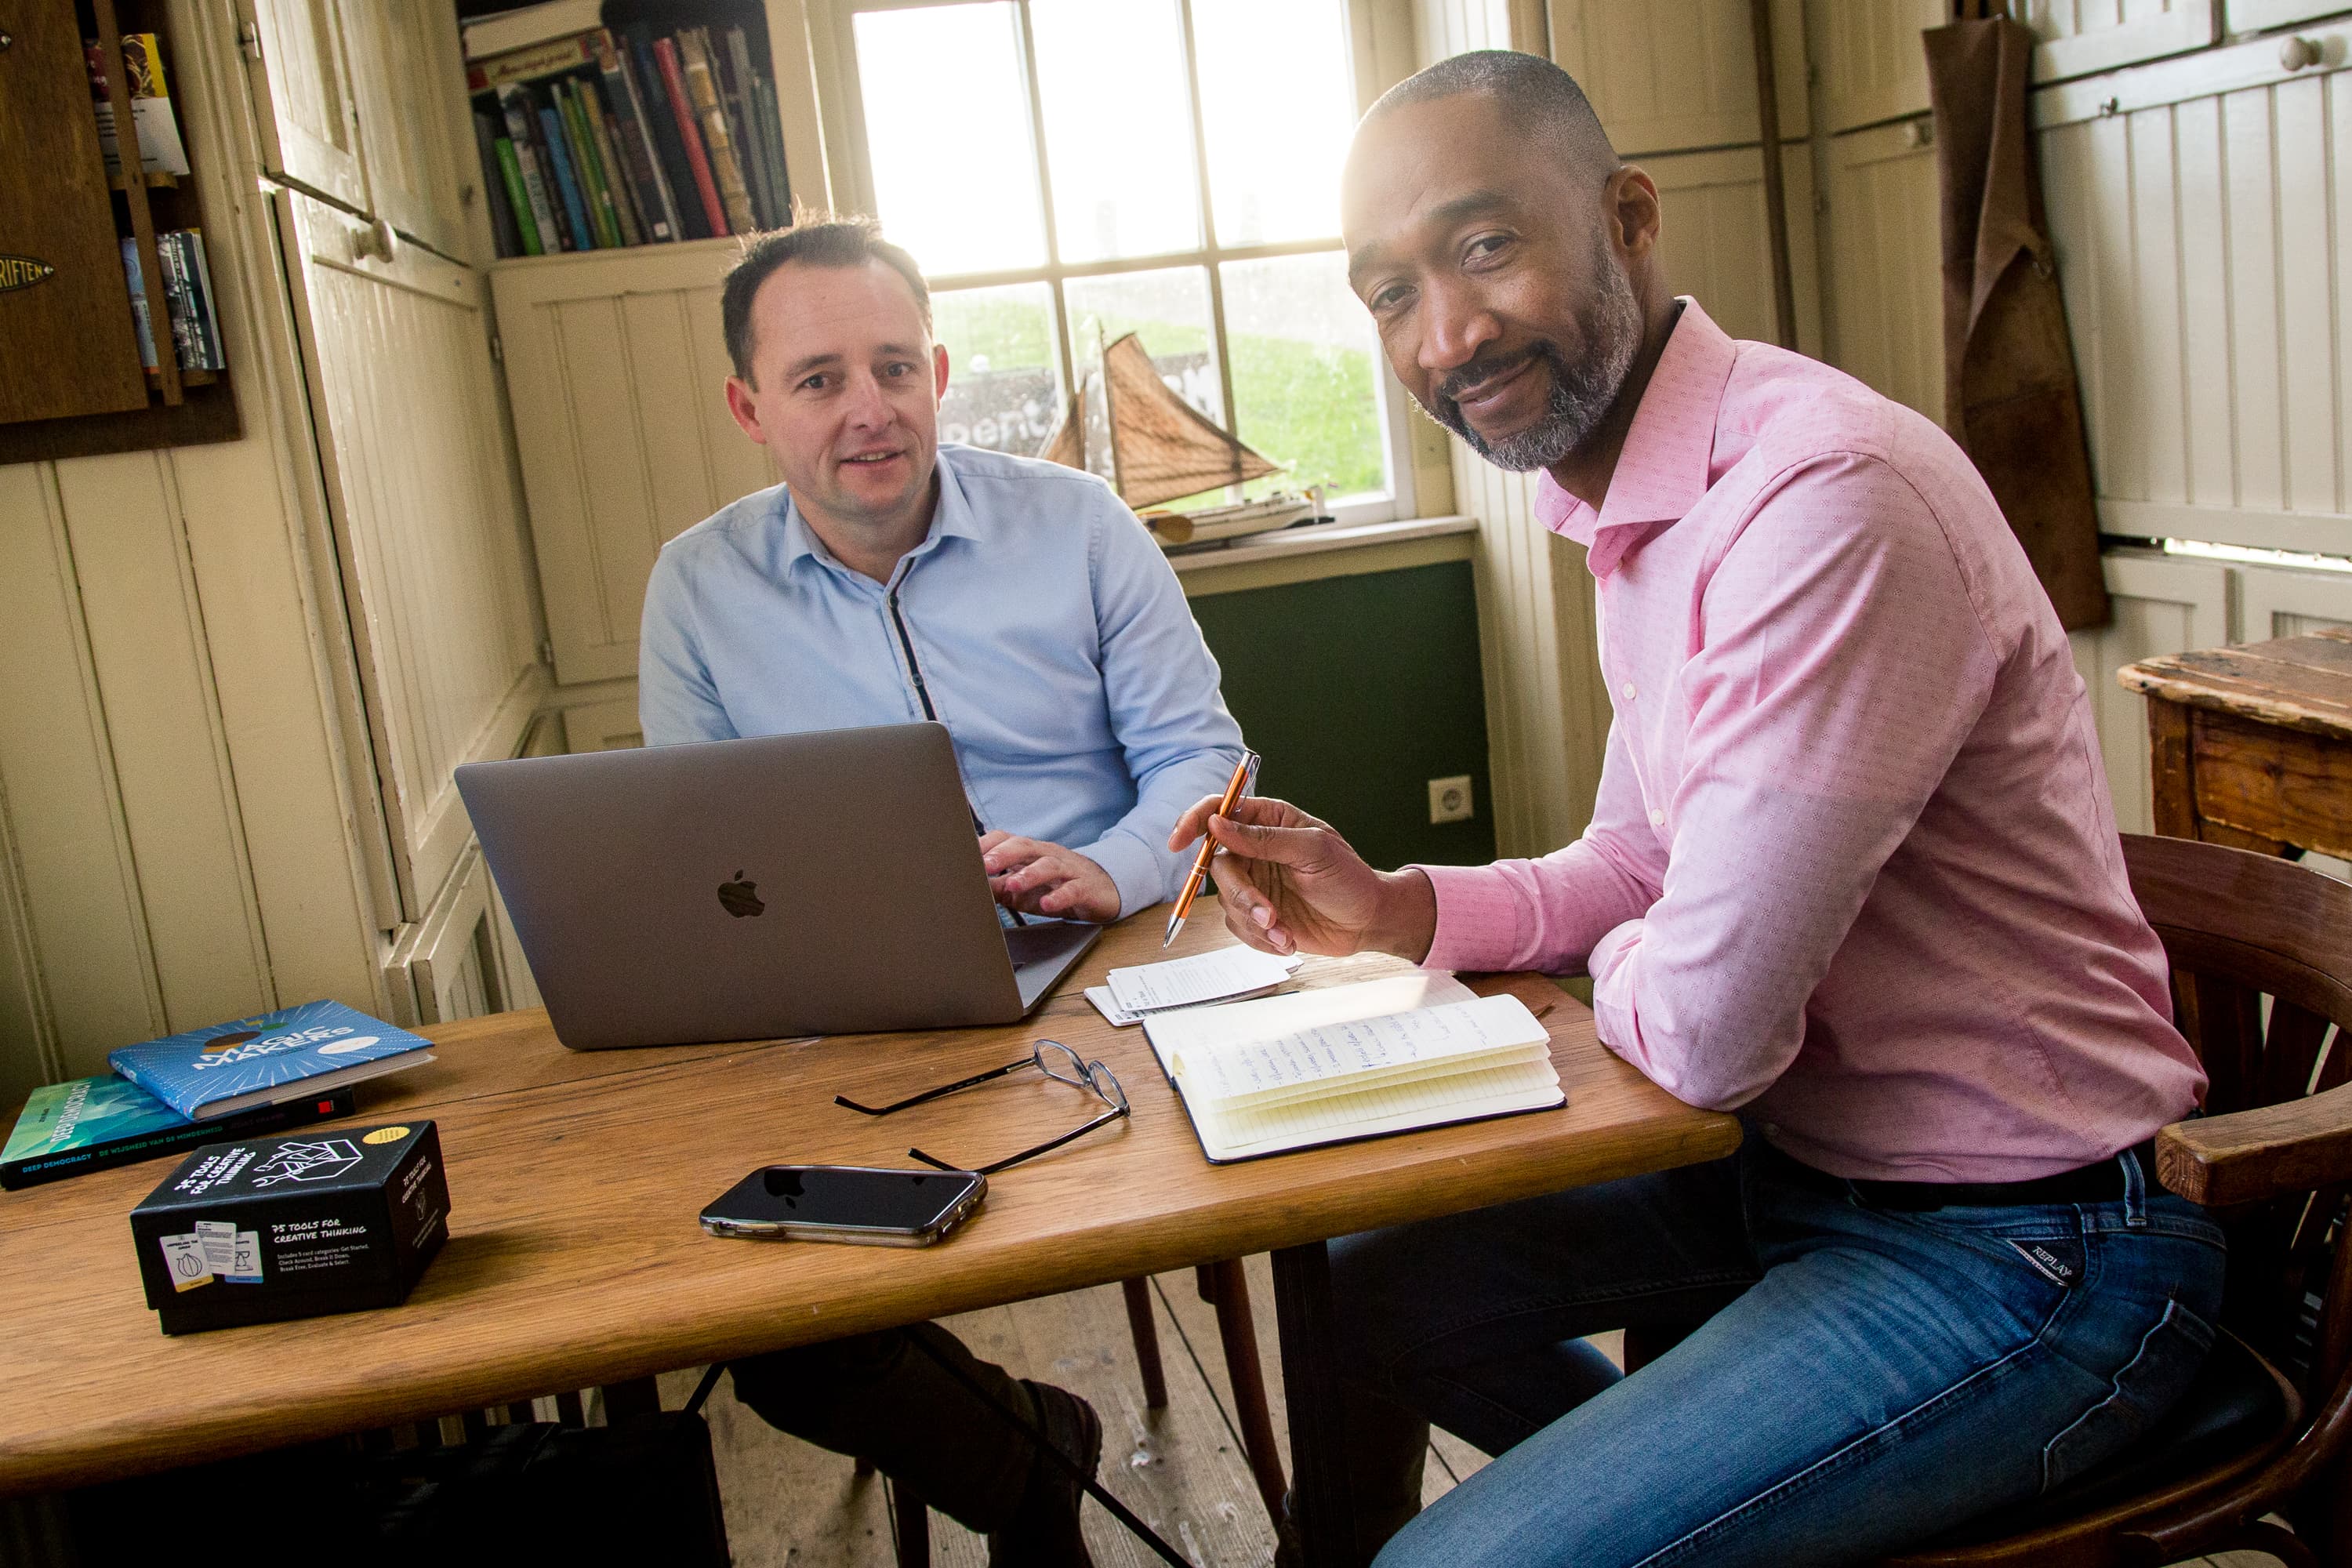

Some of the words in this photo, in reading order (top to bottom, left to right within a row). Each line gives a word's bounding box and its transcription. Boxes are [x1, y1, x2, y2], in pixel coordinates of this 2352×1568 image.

[191, 1027, 354, 1069] MAKERS
[200, 1025, 325, 1061] MAGIC
[58, 1080, 93, 1123] DEMOCRACY
[49, 1120, 77, 1143] DEEP
[22, 1164, 42, 1173] DEEP
[44, 1152, 92, 1170] DEMOCRACY
[111, 1141, 147, 1154] WIJSHEID
[149, 1138, 164, 1147] VAN
[177, 1125, 223, 1141] MINDERHEID
[189, 1155, 220, 1178] TOOLS
[190, 1179, 215, 1195] FOR
[207, 1147, 246, 1178] CREATIVE
[214, 1152, 256, 1185] THINKING
[271, 1225, 286, 1233] 75
[289, 1221, 319, 1232] TOOLS
[321, 1218, 341, 1227] FOR
[274, 1232, 318, 1243] CREATIVE
[320, 1226, 367, 1238] THINKING
[2031, 1245, 2068, 1276] REPLAY
